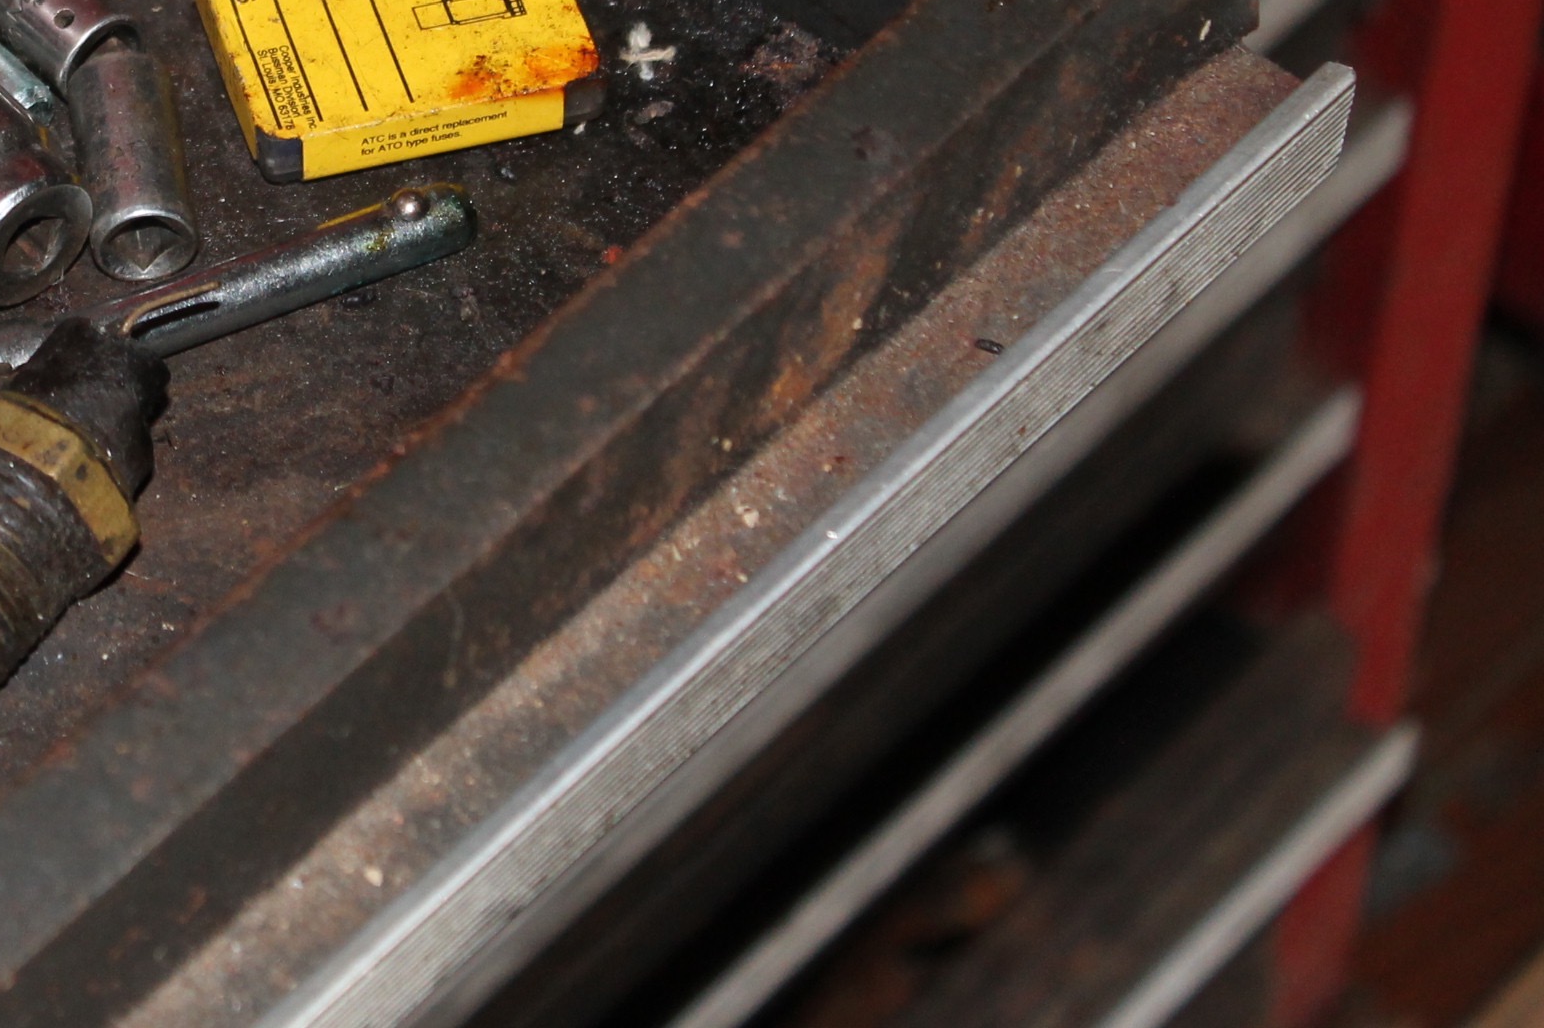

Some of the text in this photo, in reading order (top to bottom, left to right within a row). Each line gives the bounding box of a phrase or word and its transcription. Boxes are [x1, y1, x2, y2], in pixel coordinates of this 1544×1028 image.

[267, 47, 301, 118] Bussman Division
[360, 133, 385, 146] ATC
[387, 132, 397, 140] is
[409, 124, 440, 136] direct
[441, 111, 508, 130] replacement
[360, 147, 375, 156] for
[377, 140, 403, 153] ATO
[405, 137, 428, 148] type
